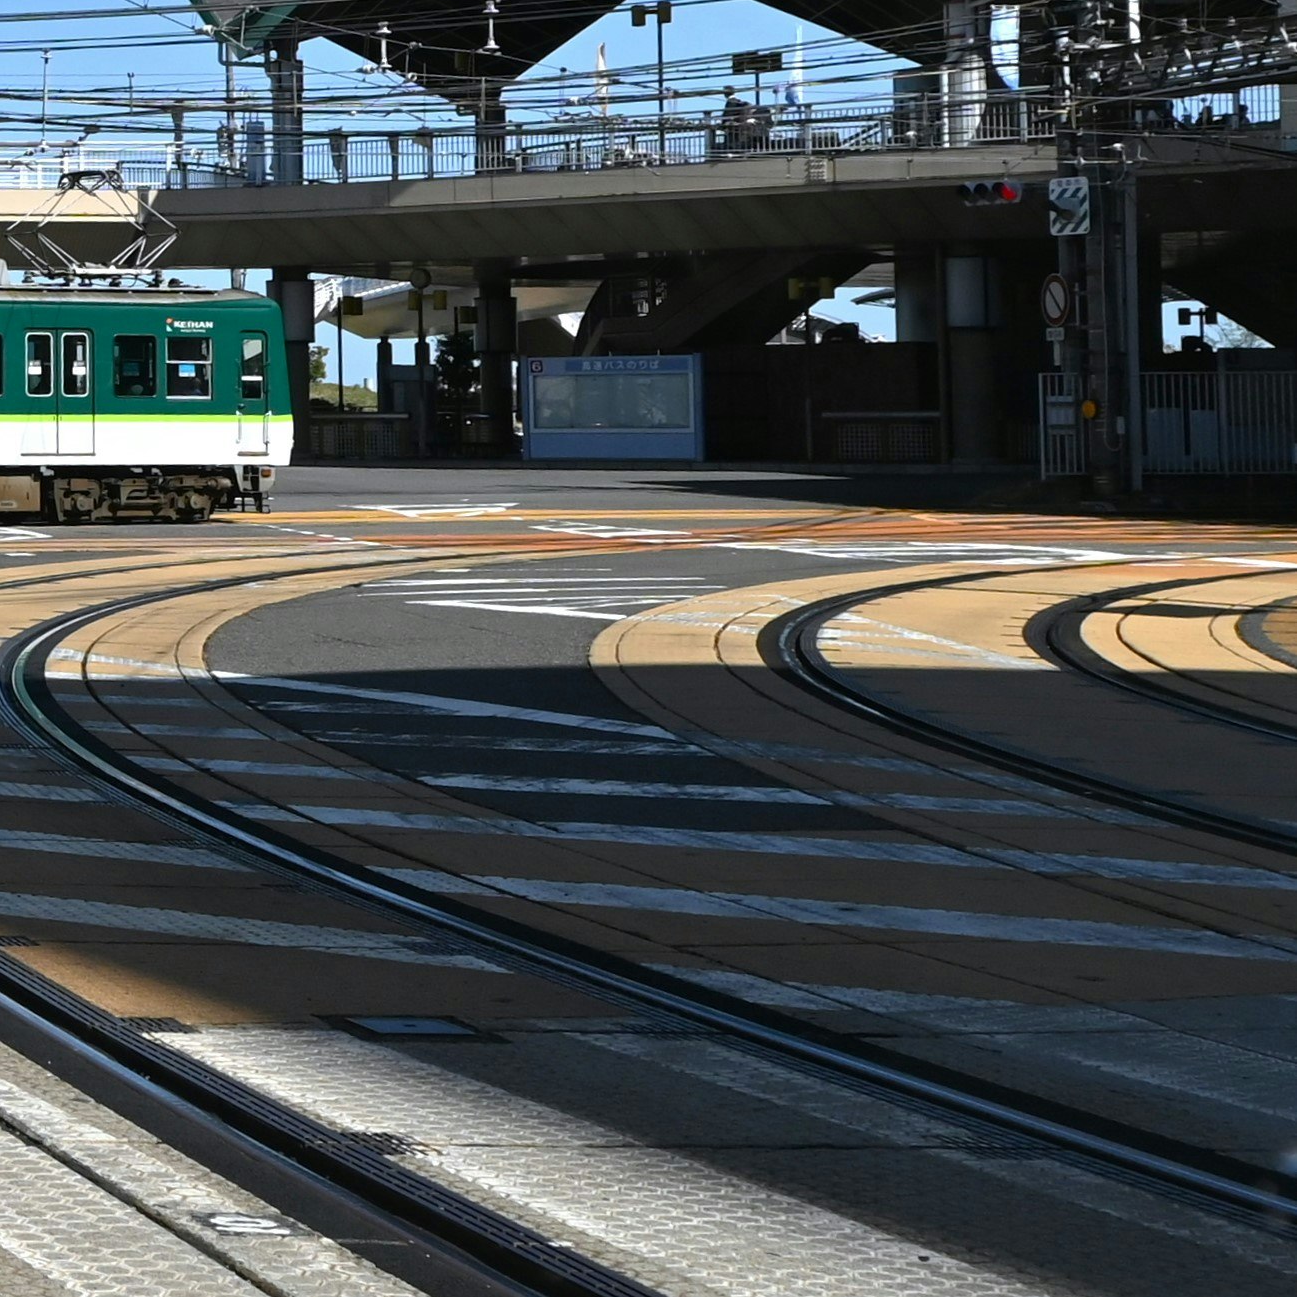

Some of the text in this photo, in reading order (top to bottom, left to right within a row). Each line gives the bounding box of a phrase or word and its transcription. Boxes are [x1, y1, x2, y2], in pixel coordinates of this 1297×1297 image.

[173, 320, 214, 328] KEIHAN
[531, 361, 542, 372] 6
[581, 360, 661, 371] 高速バスのりば
